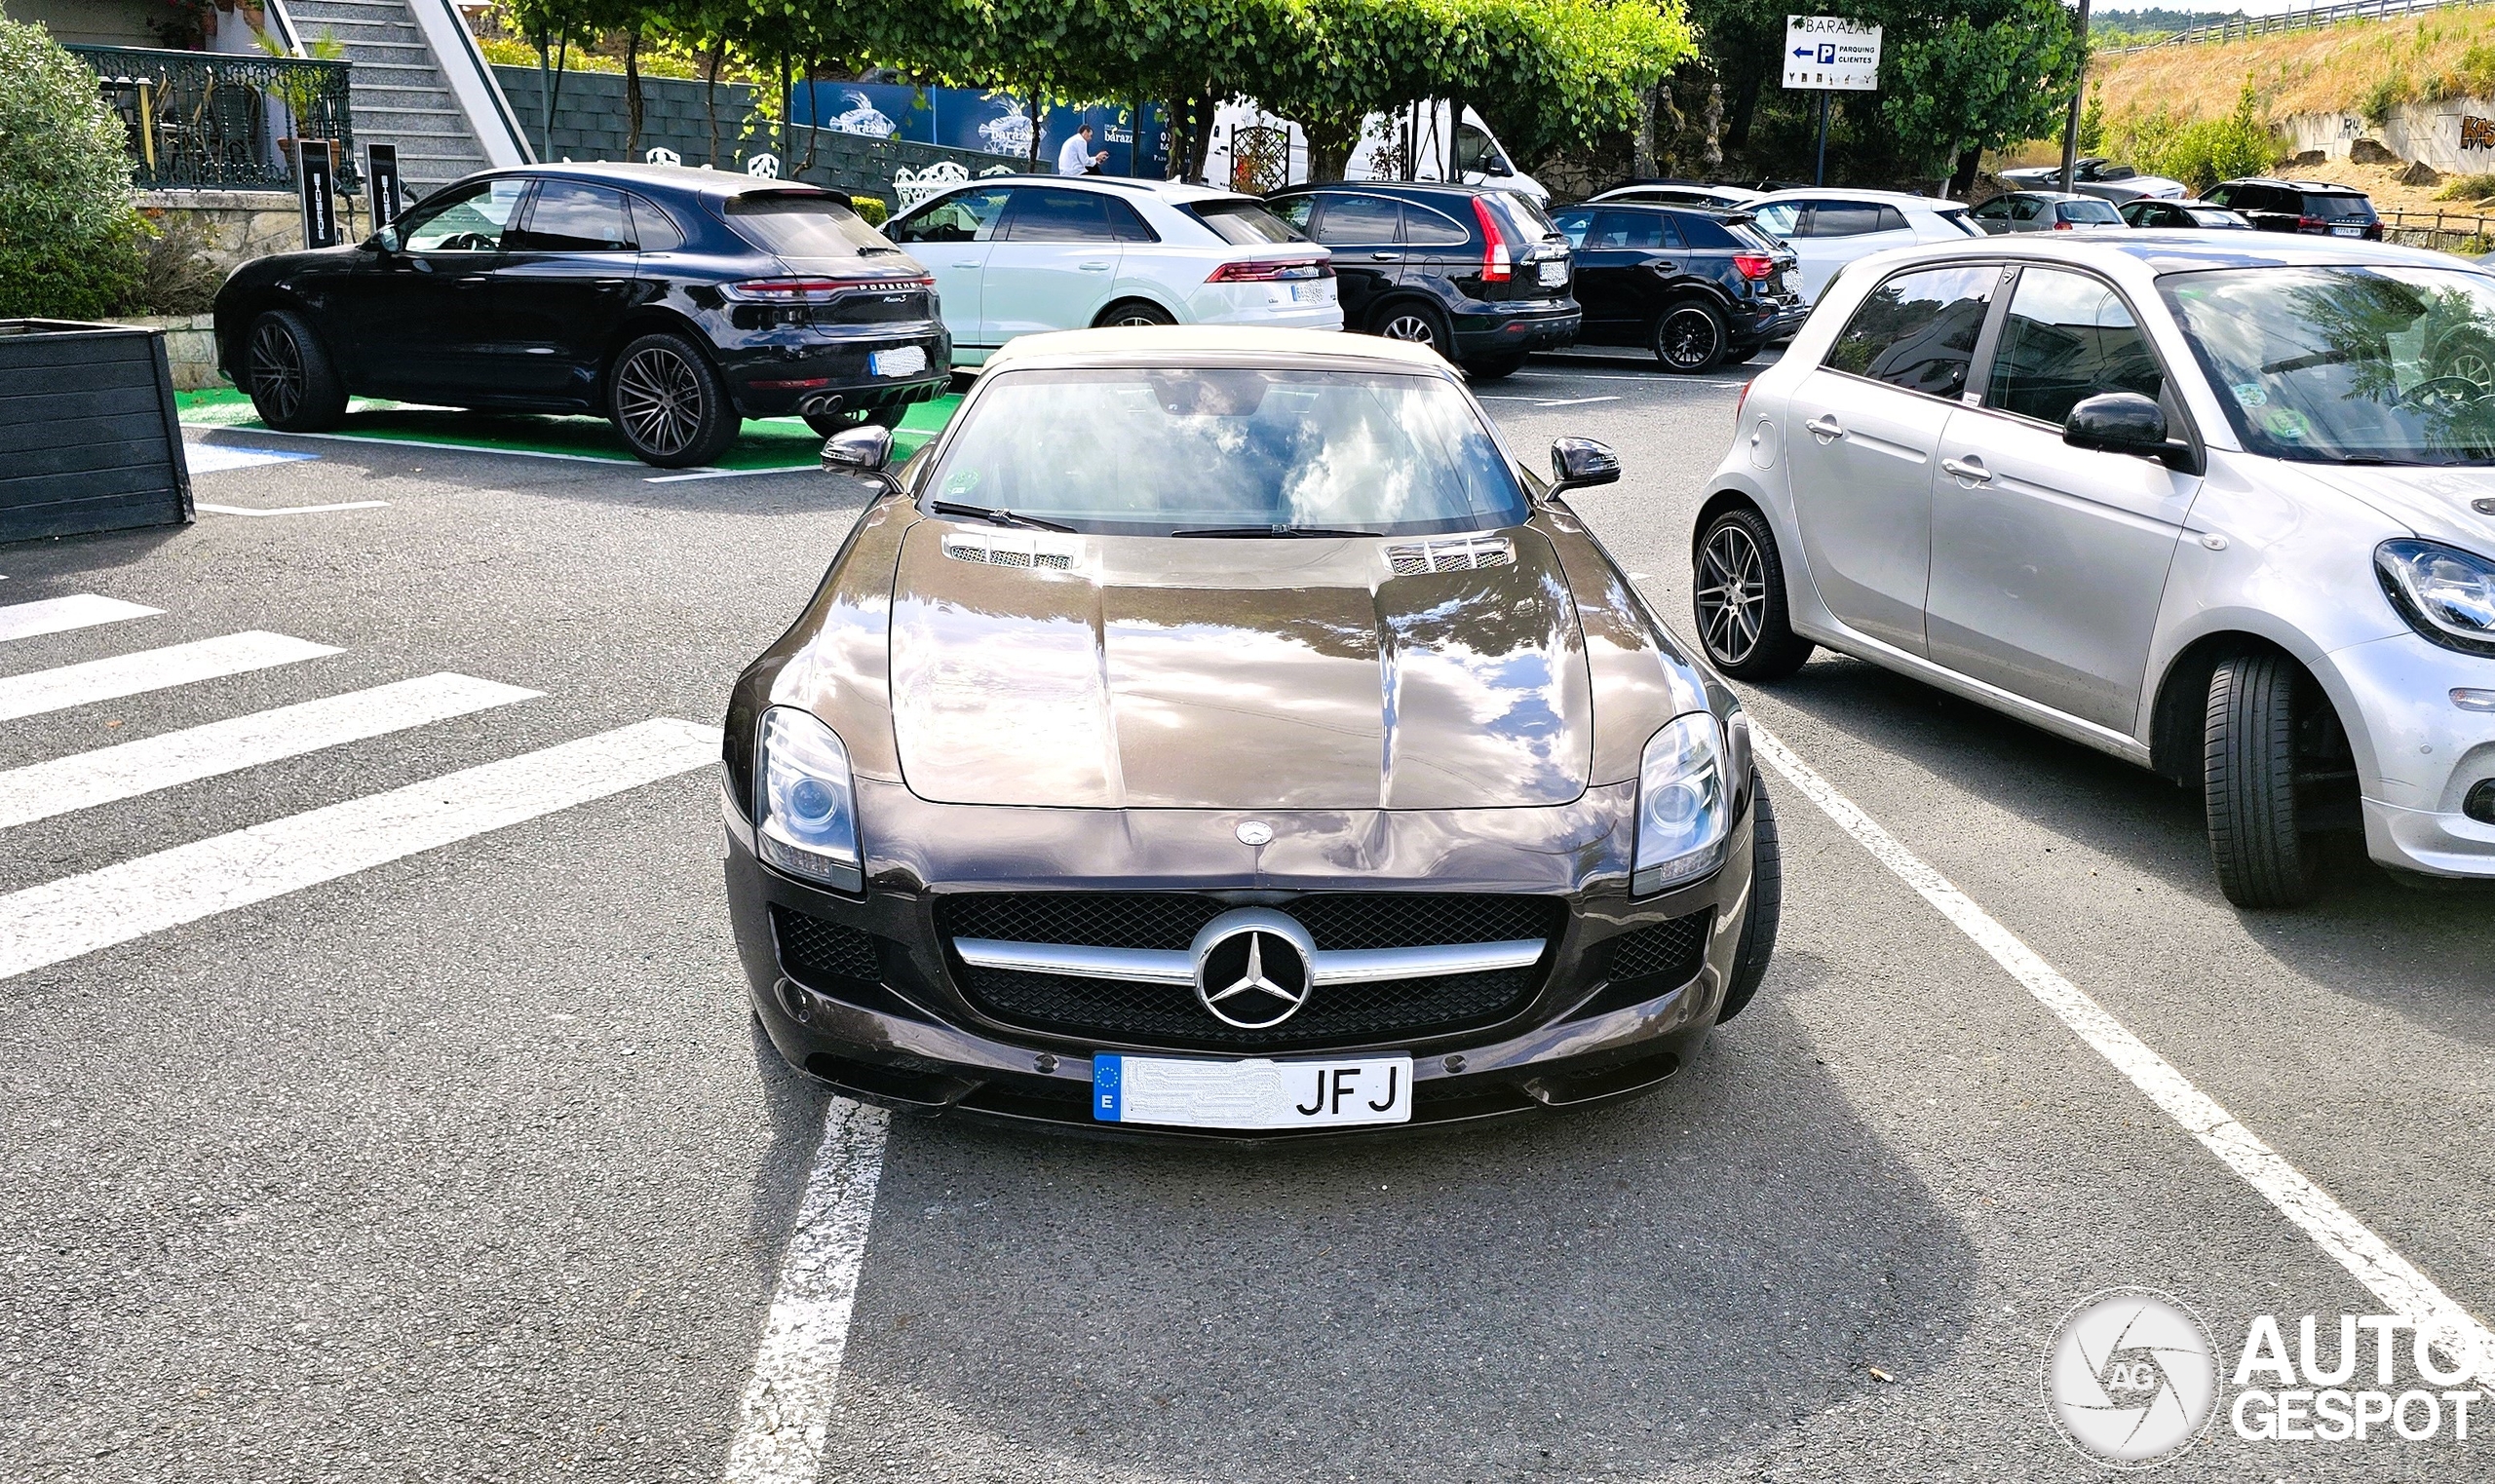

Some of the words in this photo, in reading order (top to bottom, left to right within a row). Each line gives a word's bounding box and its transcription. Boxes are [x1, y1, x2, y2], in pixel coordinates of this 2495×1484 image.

[1820, 45, 1833, 62] P
[313, 172, 326, 240] PORSCHE
[859, 282, 917, 290] PORSCHE
[1101, 1094, 1113, 1109] E
[1295, 1065, 1398, 1116] JFJ
